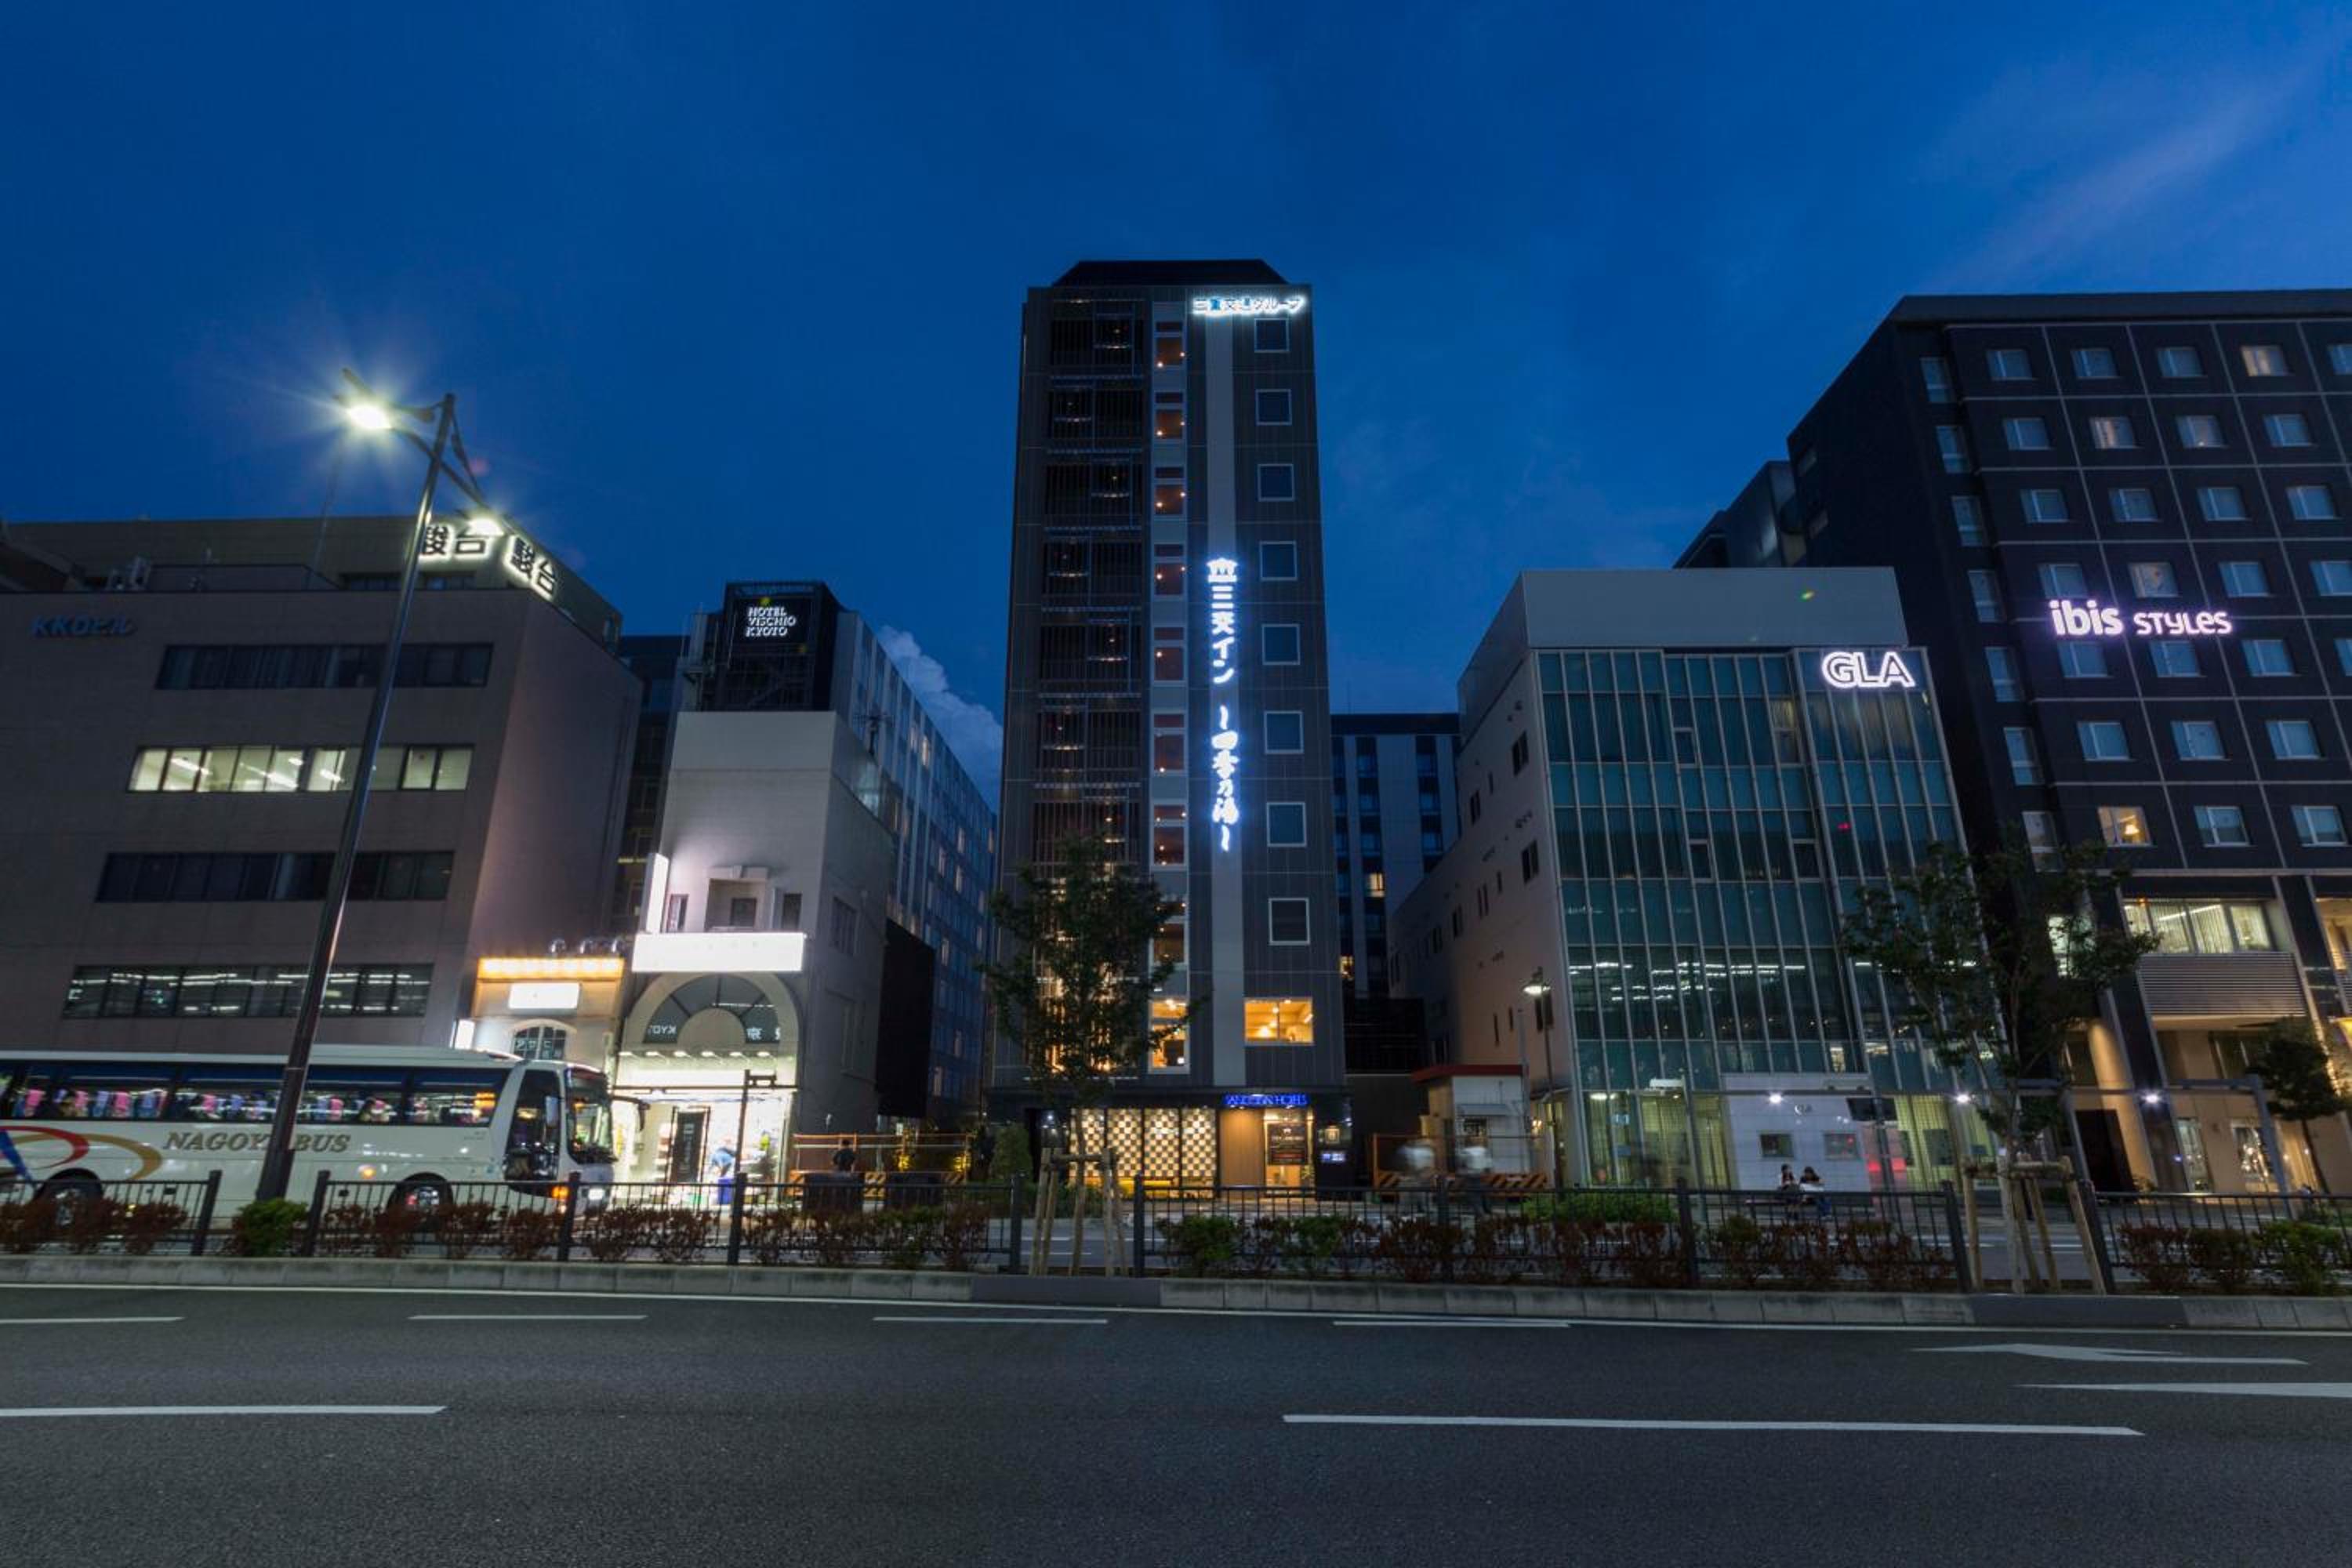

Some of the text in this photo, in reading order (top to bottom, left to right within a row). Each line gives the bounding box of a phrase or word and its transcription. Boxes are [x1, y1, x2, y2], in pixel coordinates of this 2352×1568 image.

[511, 538, 557, 597] 駿台
[748, 607, 787, 616] HOTEL
[2049, 601, 2124, 635] ibis
[746, 626, 788, 637] KYOTO
[1211, 586, 1235, 684] 三交イン
[1823, 652, 1915, 687] GLA
[163, 1131, 351, 1152] NAGOY BUS
